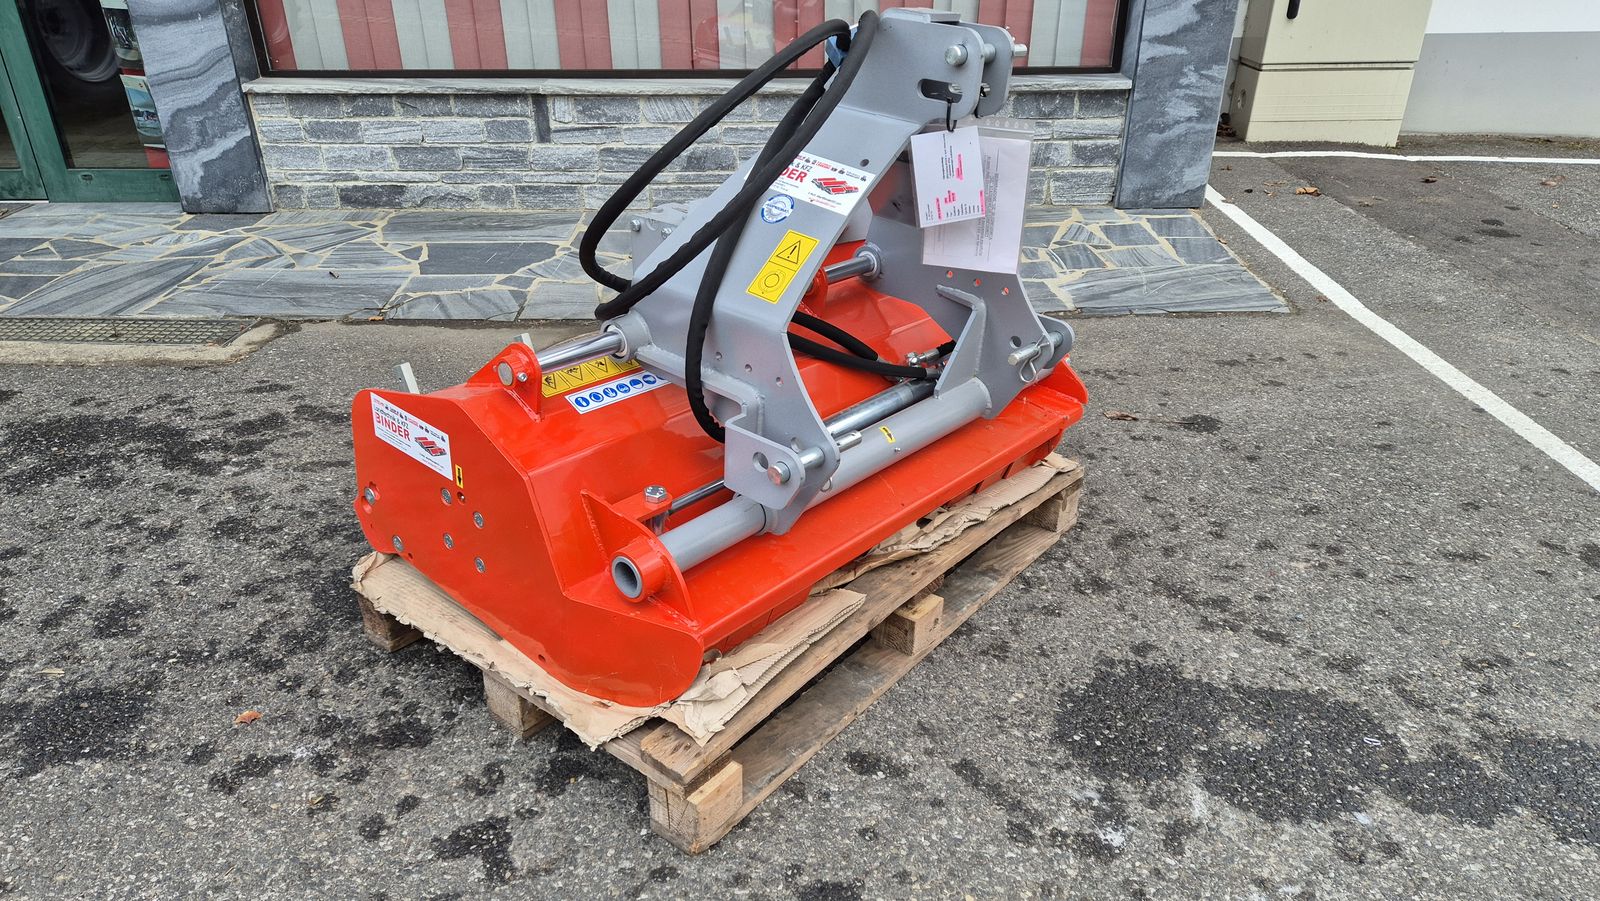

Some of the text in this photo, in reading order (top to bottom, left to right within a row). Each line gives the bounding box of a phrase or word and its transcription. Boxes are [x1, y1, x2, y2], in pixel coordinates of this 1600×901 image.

[801, 164, 813, 172] KFZ
[780, 168, 808, 182] DER
[374, 411, 411, 441] BINDER
[401, 420, 409, 429] KFZ
